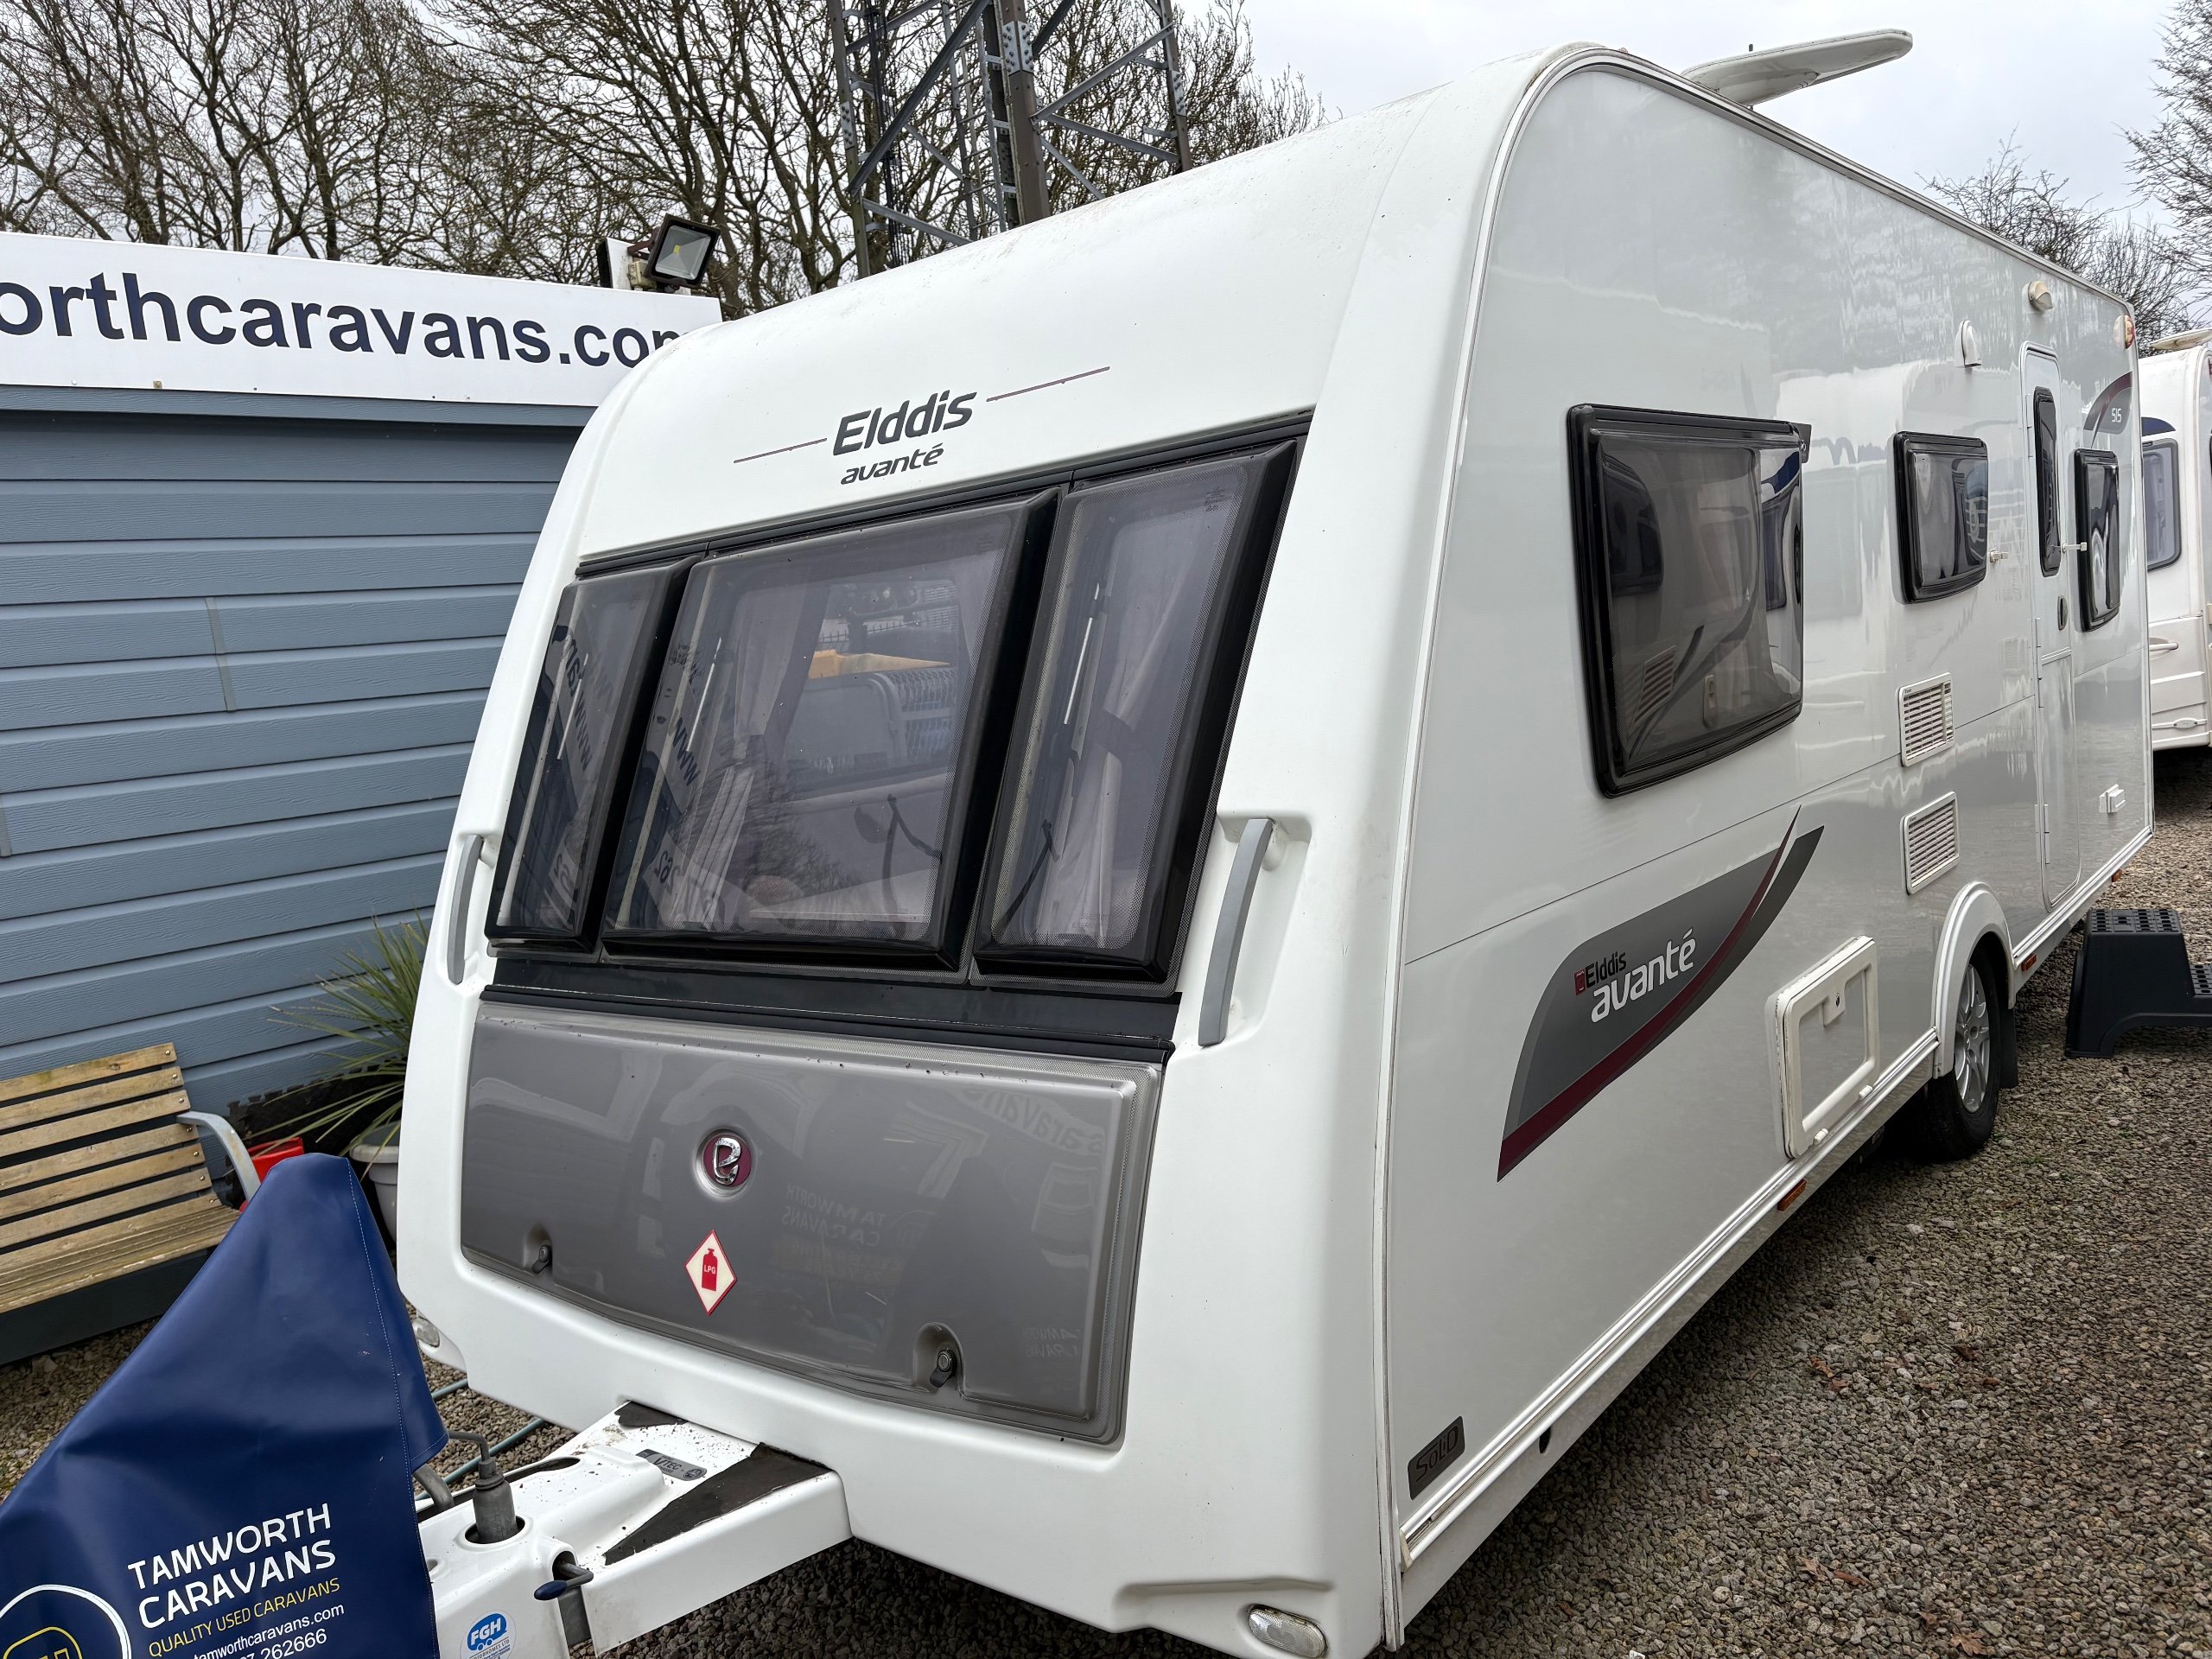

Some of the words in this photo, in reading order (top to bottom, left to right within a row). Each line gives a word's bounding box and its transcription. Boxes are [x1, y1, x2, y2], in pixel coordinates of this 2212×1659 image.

[832, 389, 977, 456] Elddis
[840, 442, 944, 486] avanté
[1585, 950, 1627, 988] Elddis
[1591, 927, 1696, 1023] avanté
[703, 1264, 716, 1274] LPG
[127, 1503, 332, 1590] TAMWORTH
[138, 1539, 336, 1629] CARAVANS
[148, 1620, 213, 1657] QUALITY
[215, 1607, 251, 1631] USED
[253, 1577, 341, 1618] CARAVANS
[470, 1618, 501, 1645] FGH
[471, 1643, 501, 1659] OTORHOMES
